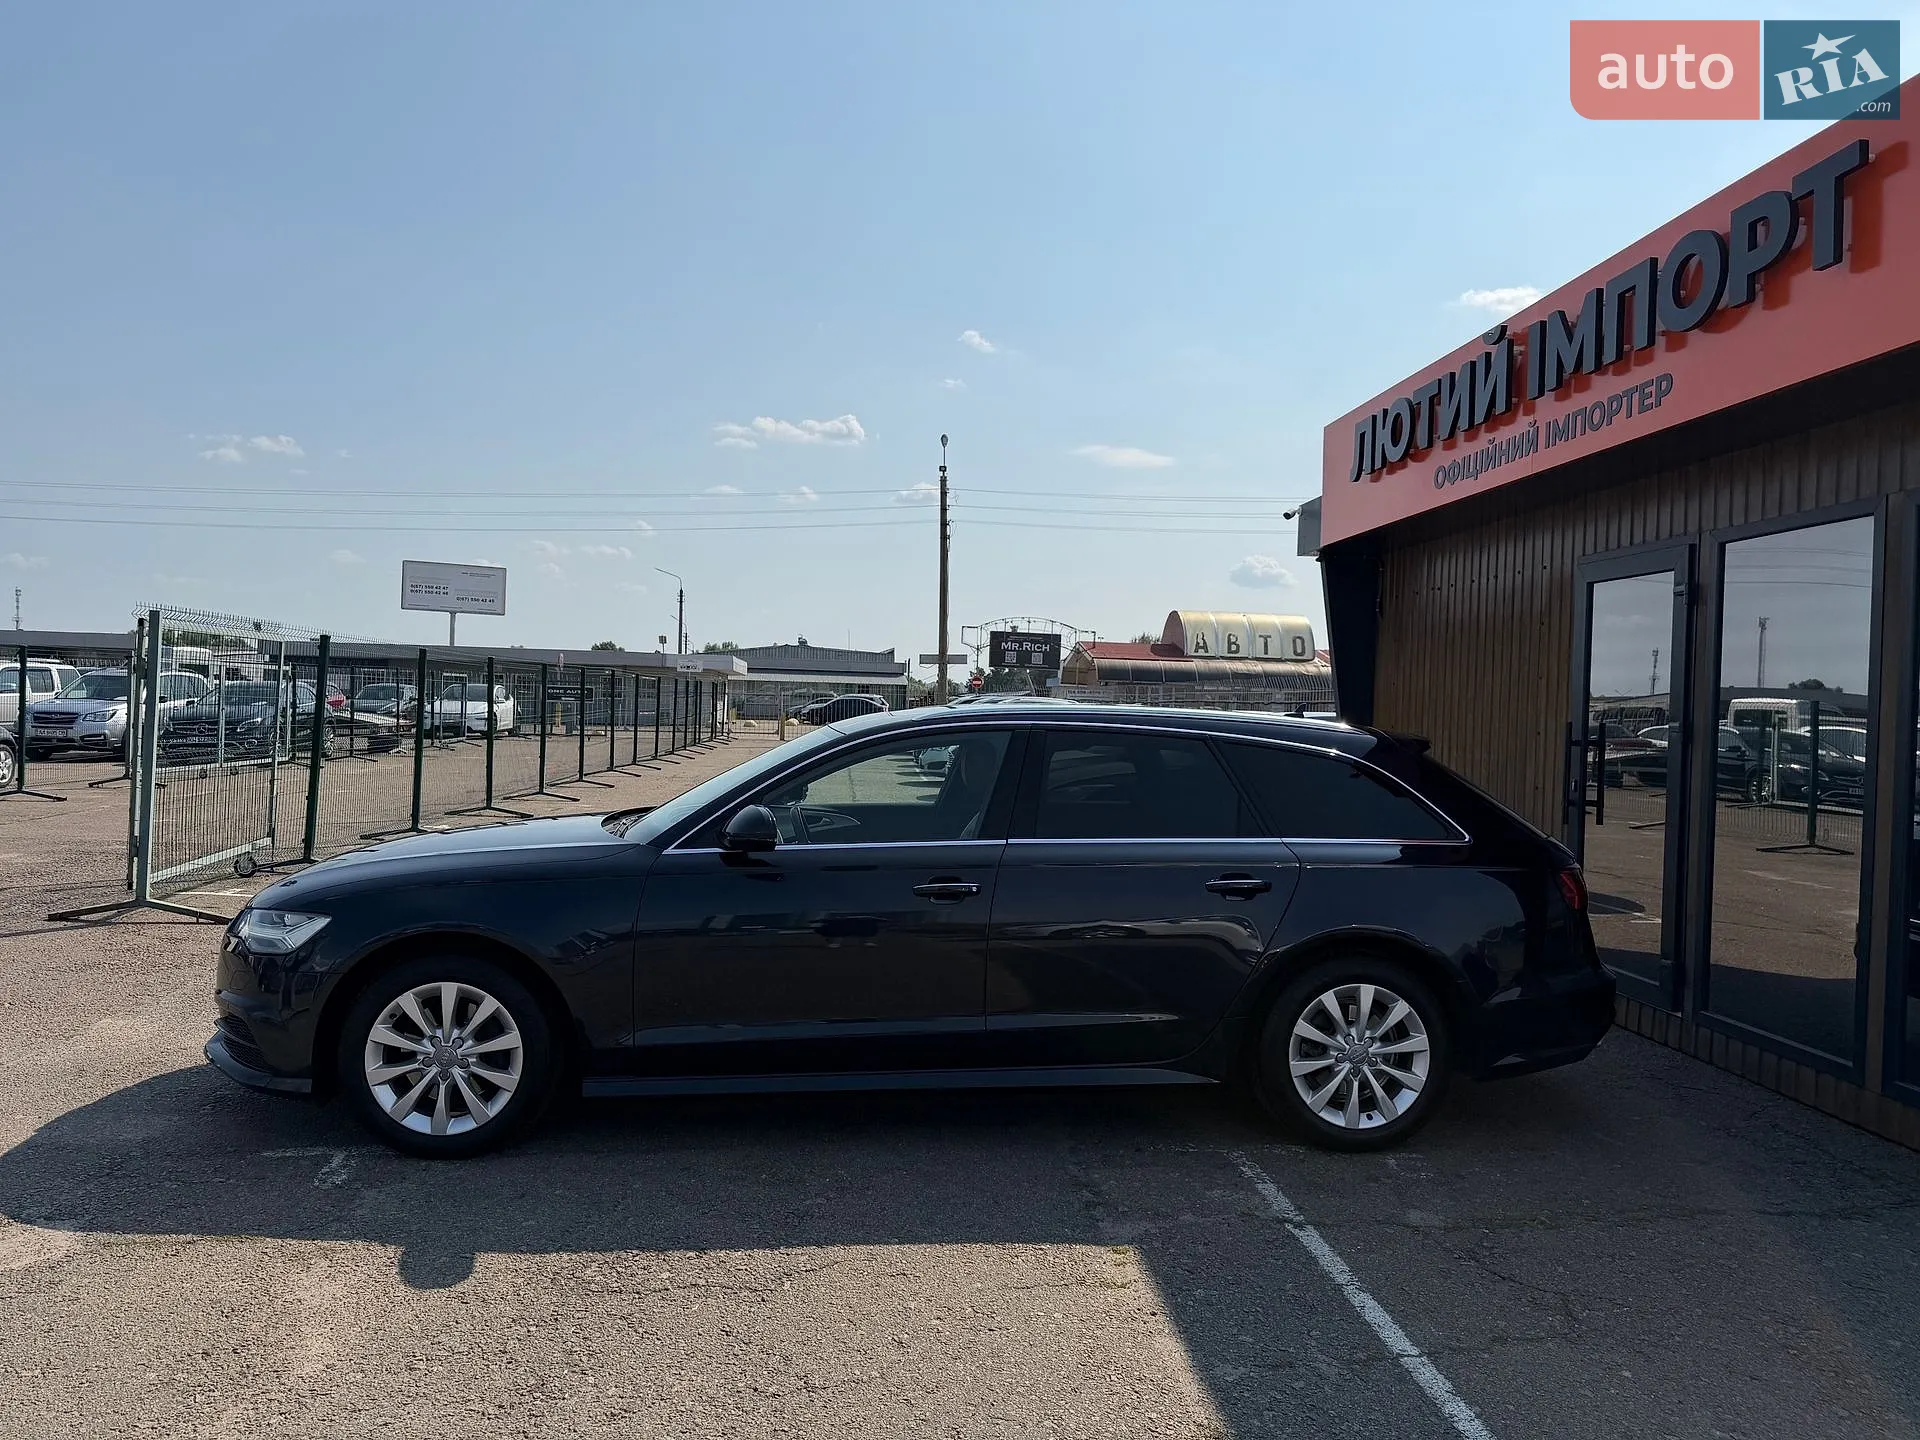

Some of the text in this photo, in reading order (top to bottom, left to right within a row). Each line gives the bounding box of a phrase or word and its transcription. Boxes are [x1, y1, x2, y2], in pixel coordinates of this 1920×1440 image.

[1350, 139, 1869, 482] ЛЮТИЙ ІМПОРТ
[1433, 373, 1673, 490] ОФІЦІЙНИЙ ІМПОРТЕР
[1193, 632, 1306, 657] АВТО
